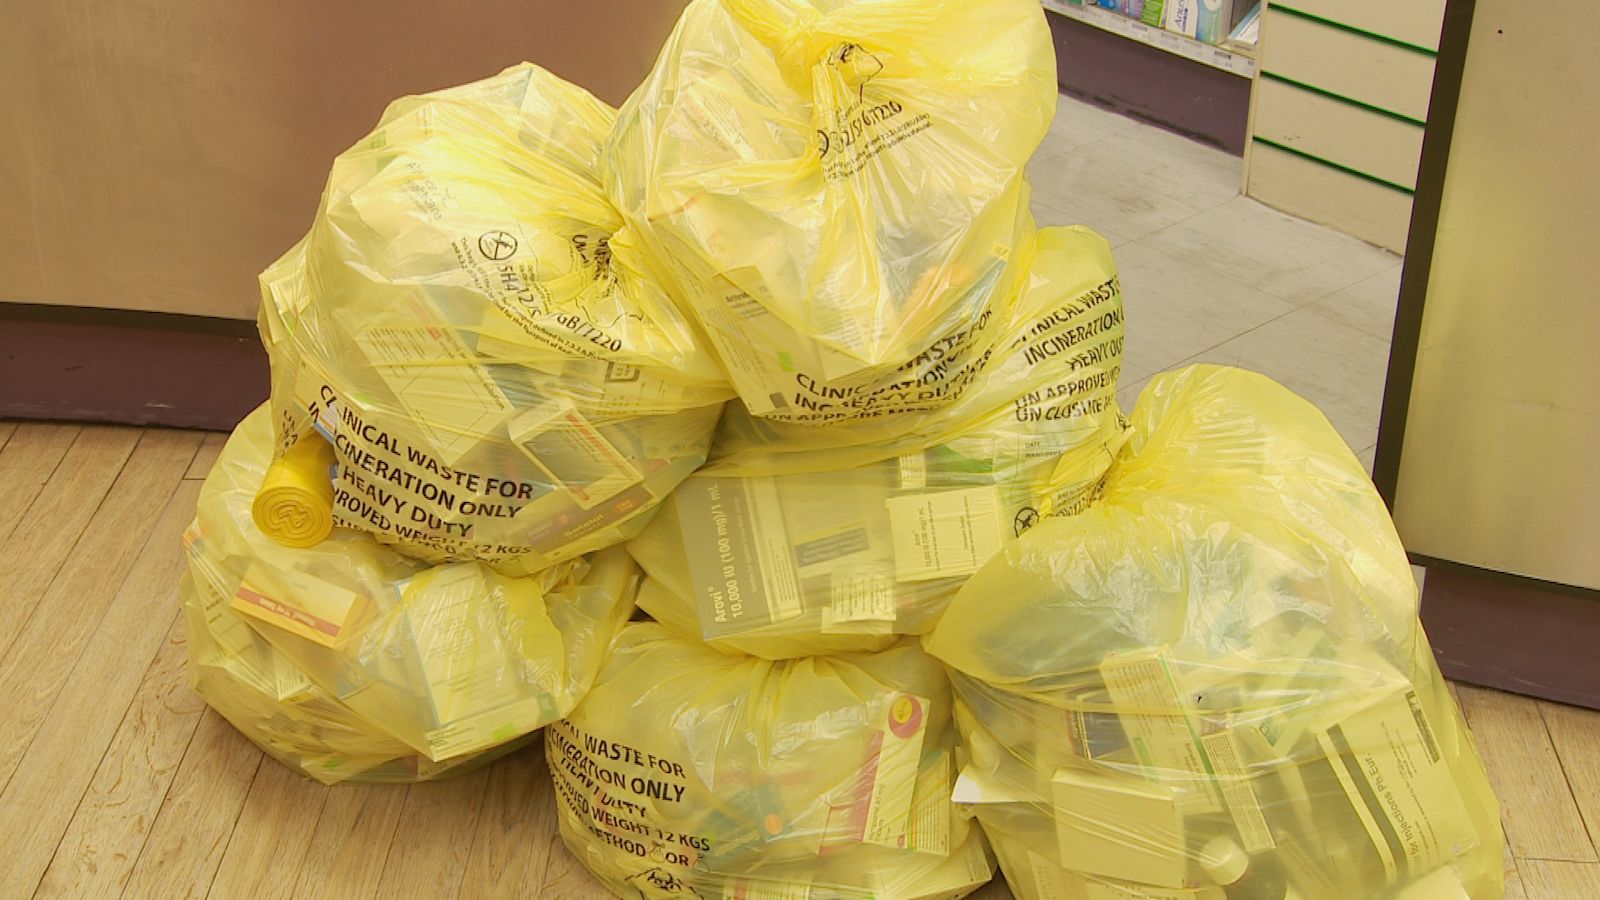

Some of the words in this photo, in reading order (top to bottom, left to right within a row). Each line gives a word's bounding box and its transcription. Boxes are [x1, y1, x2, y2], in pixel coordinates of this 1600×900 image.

[407, 447, 480, 492] WASTE
[485, 478, 533, 499] FOR
[333, 487, 391, 531] PROVED
[496, 544, 531, 554] KGS
[344, 467, 408, 514] HEAVY
[411, 506, 473, 537] DUTY
[459, 501, 521, 519] ONLY
[551, 727, 626, 790] CINERATION
[631, 778, 686, 803] ONLY
[584, 733, 644, 767] WASTE
[648, 754, 686, 779] FOR
[592, 806, 649, 836] WEIGHT
[656, 829, 674, 842] 12
[680, 834, 710, 851] KGS
[666, 852, 689, 866] OR
